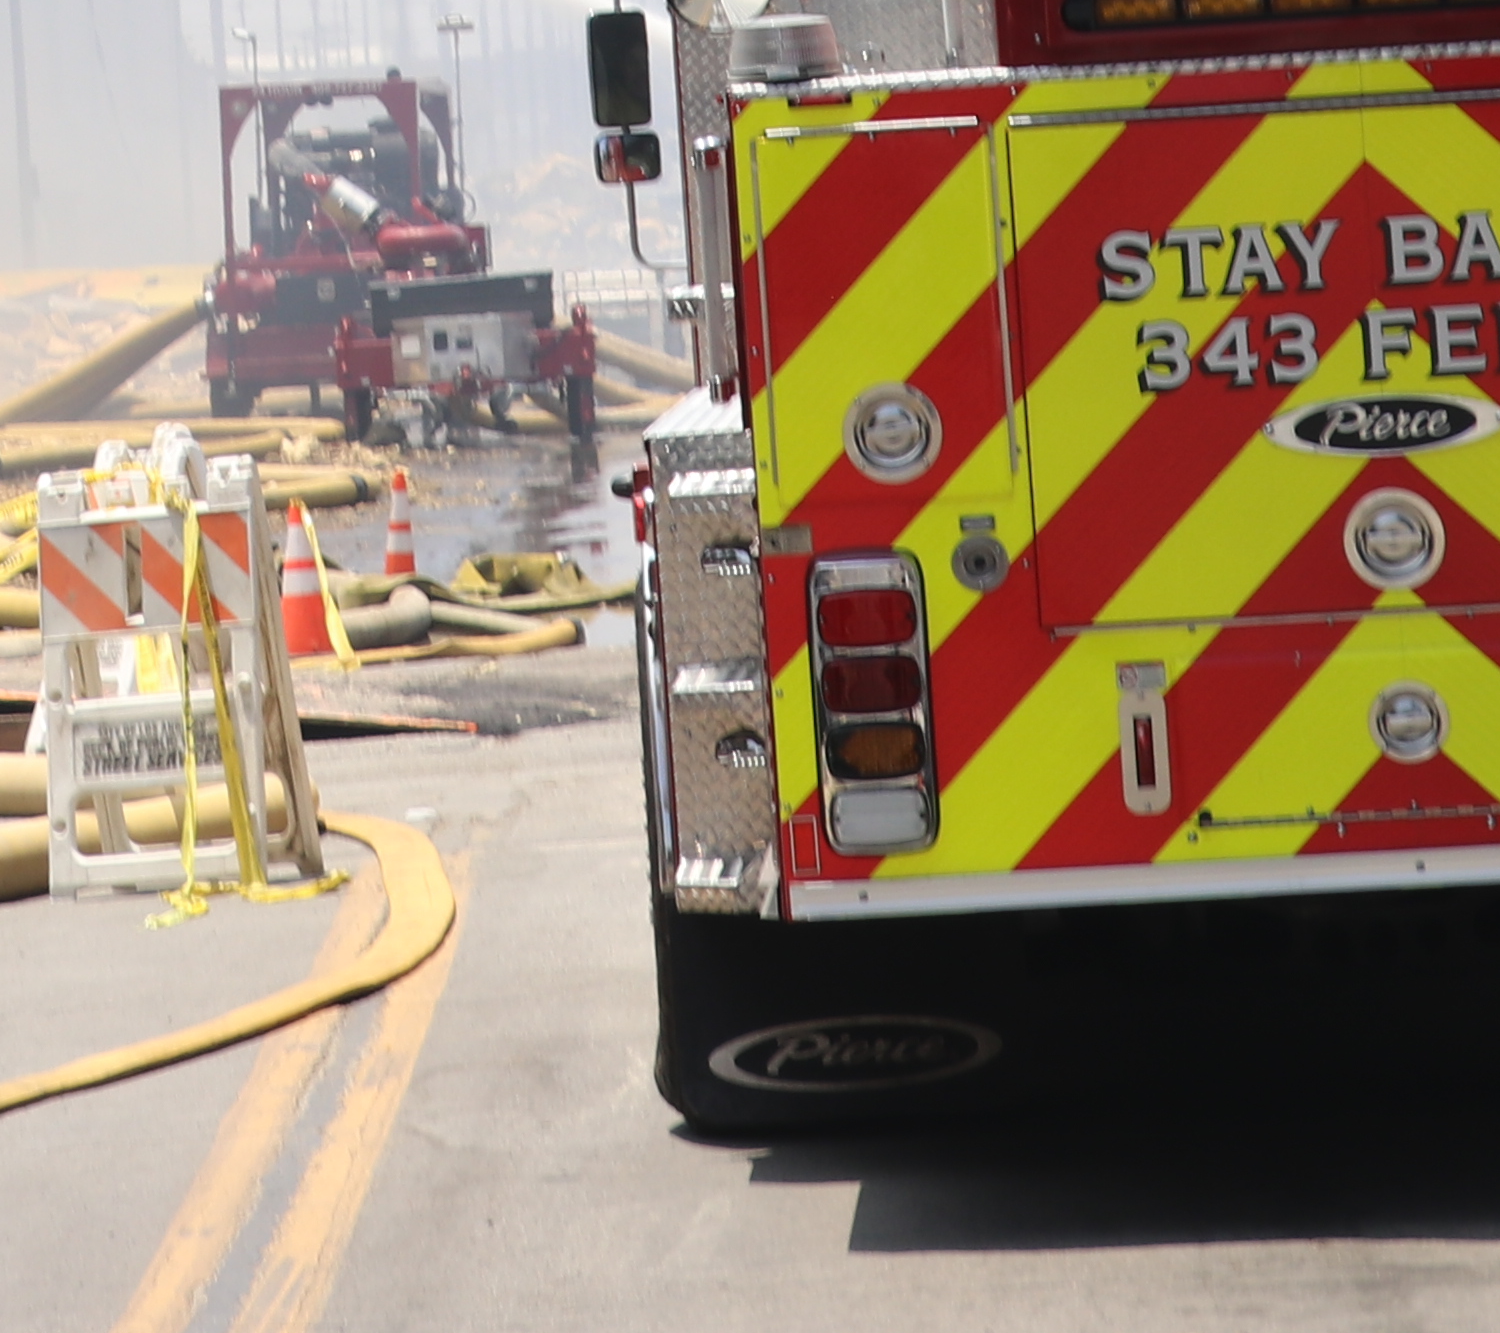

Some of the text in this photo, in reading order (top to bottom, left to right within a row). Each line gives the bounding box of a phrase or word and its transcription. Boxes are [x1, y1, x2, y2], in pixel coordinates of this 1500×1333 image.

[1099, 218, 1341, 301] STAY
[1137, 311, 1320, 393] 343
[1318, 399, 1451, 448] Pierce
[147, 749, 222, 770] SERVCES
